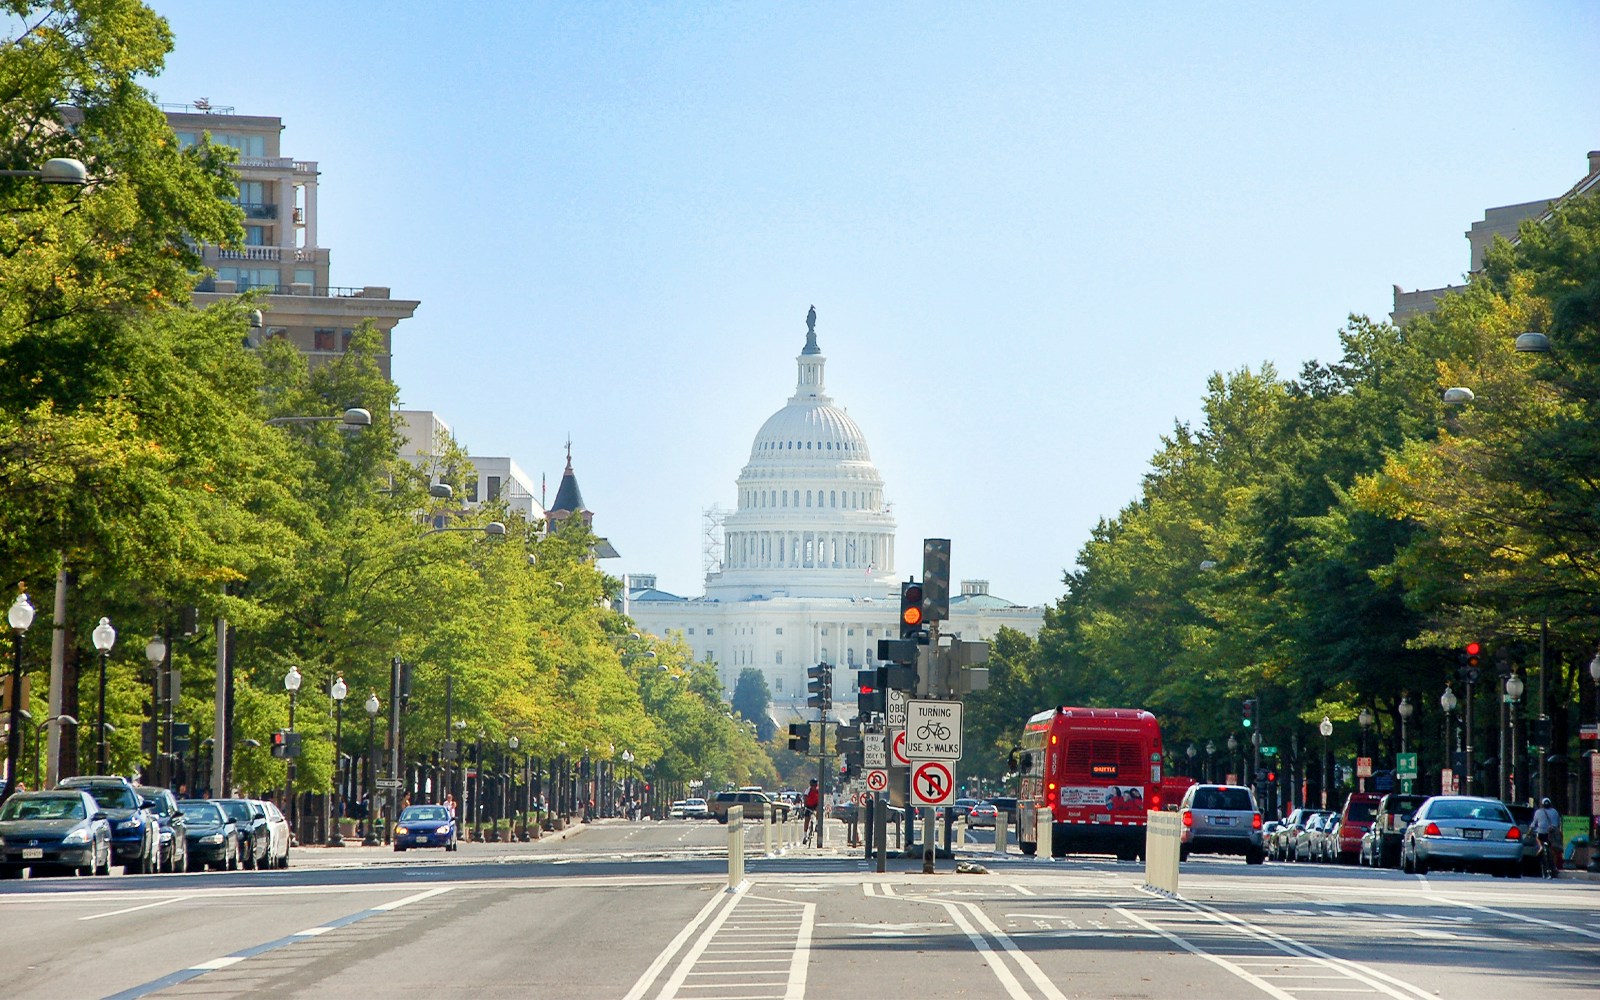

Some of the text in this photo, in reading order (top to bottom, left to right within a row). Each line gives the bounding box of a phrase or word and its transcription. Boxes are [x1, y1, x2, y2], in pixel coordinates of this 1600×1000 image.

[919, 708, 951, 717] TURNING
[907, 743, 959, 753] USE X-WALKS
